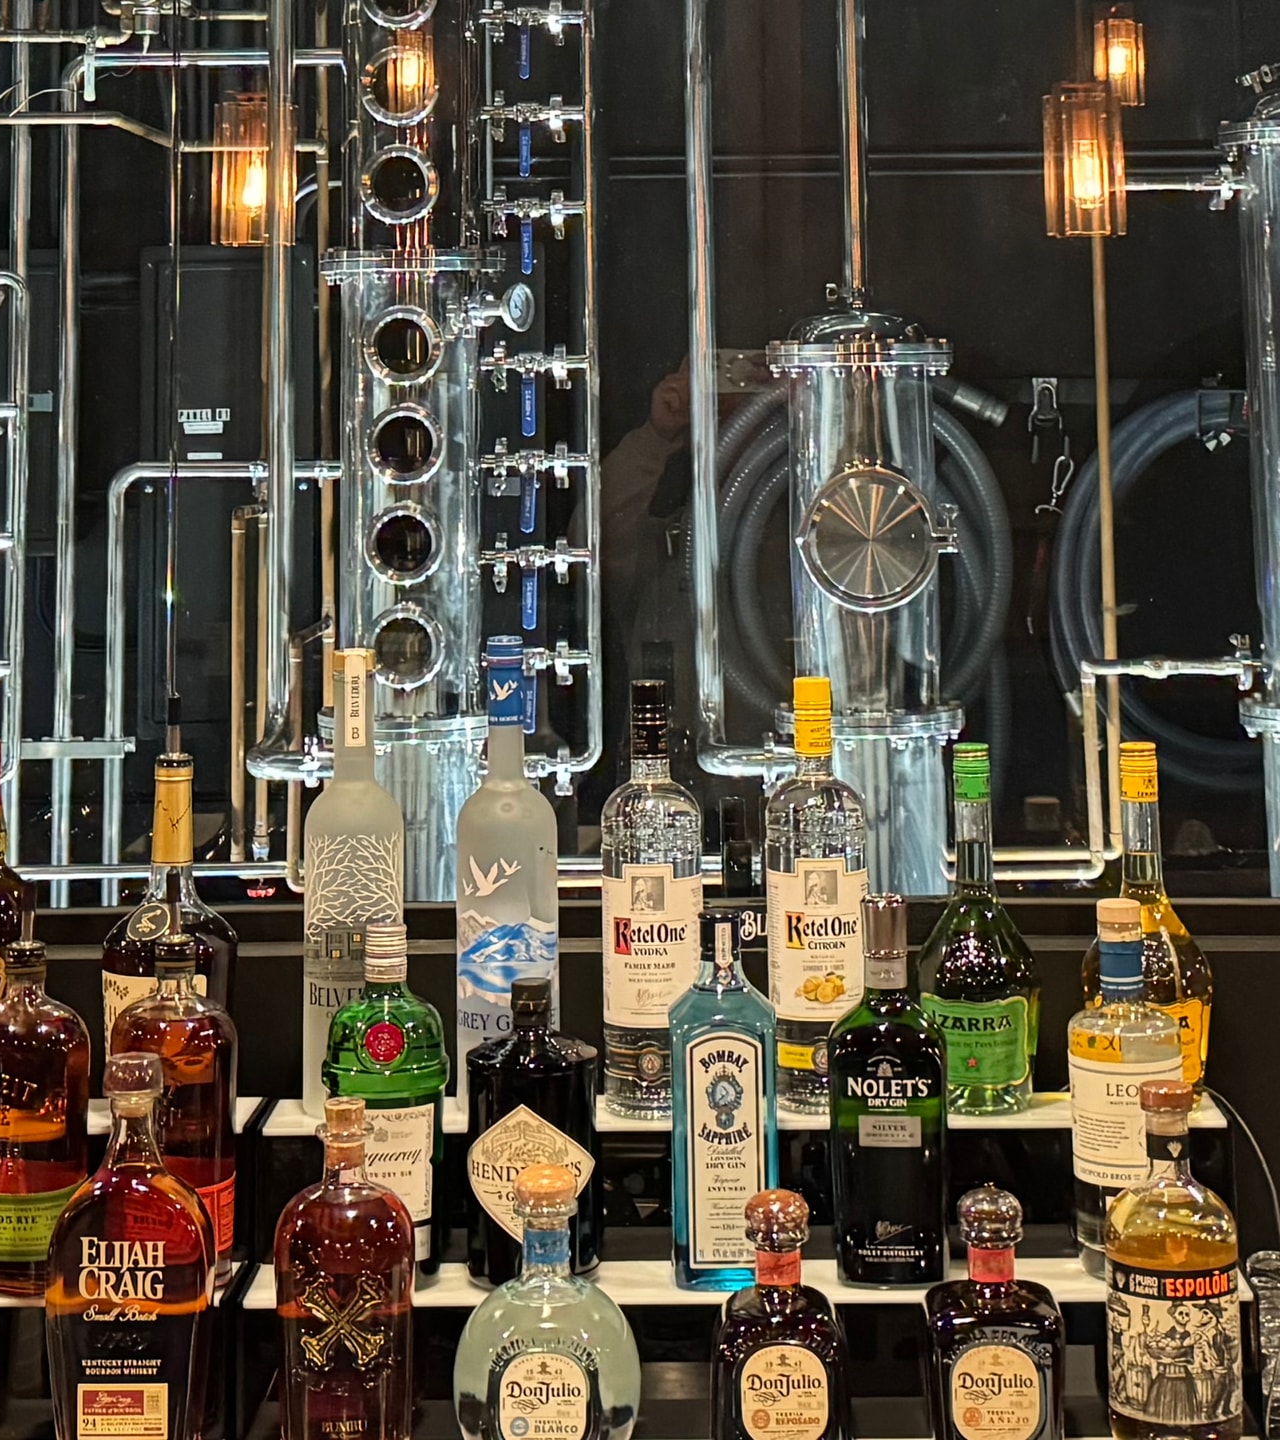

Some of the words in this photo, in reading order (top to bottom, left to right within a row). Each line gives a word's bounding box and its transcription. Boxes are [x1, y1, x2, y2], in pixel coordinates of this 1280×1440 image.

[615, 920, 654, 950] Ketel
[657, 923, 686, 943] One
[787, 914, 828, 946] Ketel
[831, 916, 857, 937] One
[634, 947, 668, 957] VODKA
[699, 1050, 749, 1073] BOMBAY
[847, 1076, 929, 1097] NOLET'S
[868, 1098, 887, 1107] DRY
[889, 1098, 907, 1107] GIN
[698, 1122, 752, 1145] SAPPHIRE
[872, 1124, 907, 1132] SILVER
[365, 1148, 422, 1166] queray
[16, 1214, 39, 1225] RYE
[79, 1236, 166, 1273] ELIJAH
[78, 1267, 164, 1304] CRAIG
[83, 1304, 121, 1321] Small
[534, 1425, 578, 1433] BLANCO
[776, 1417, 820, 1426] REPOSADO
